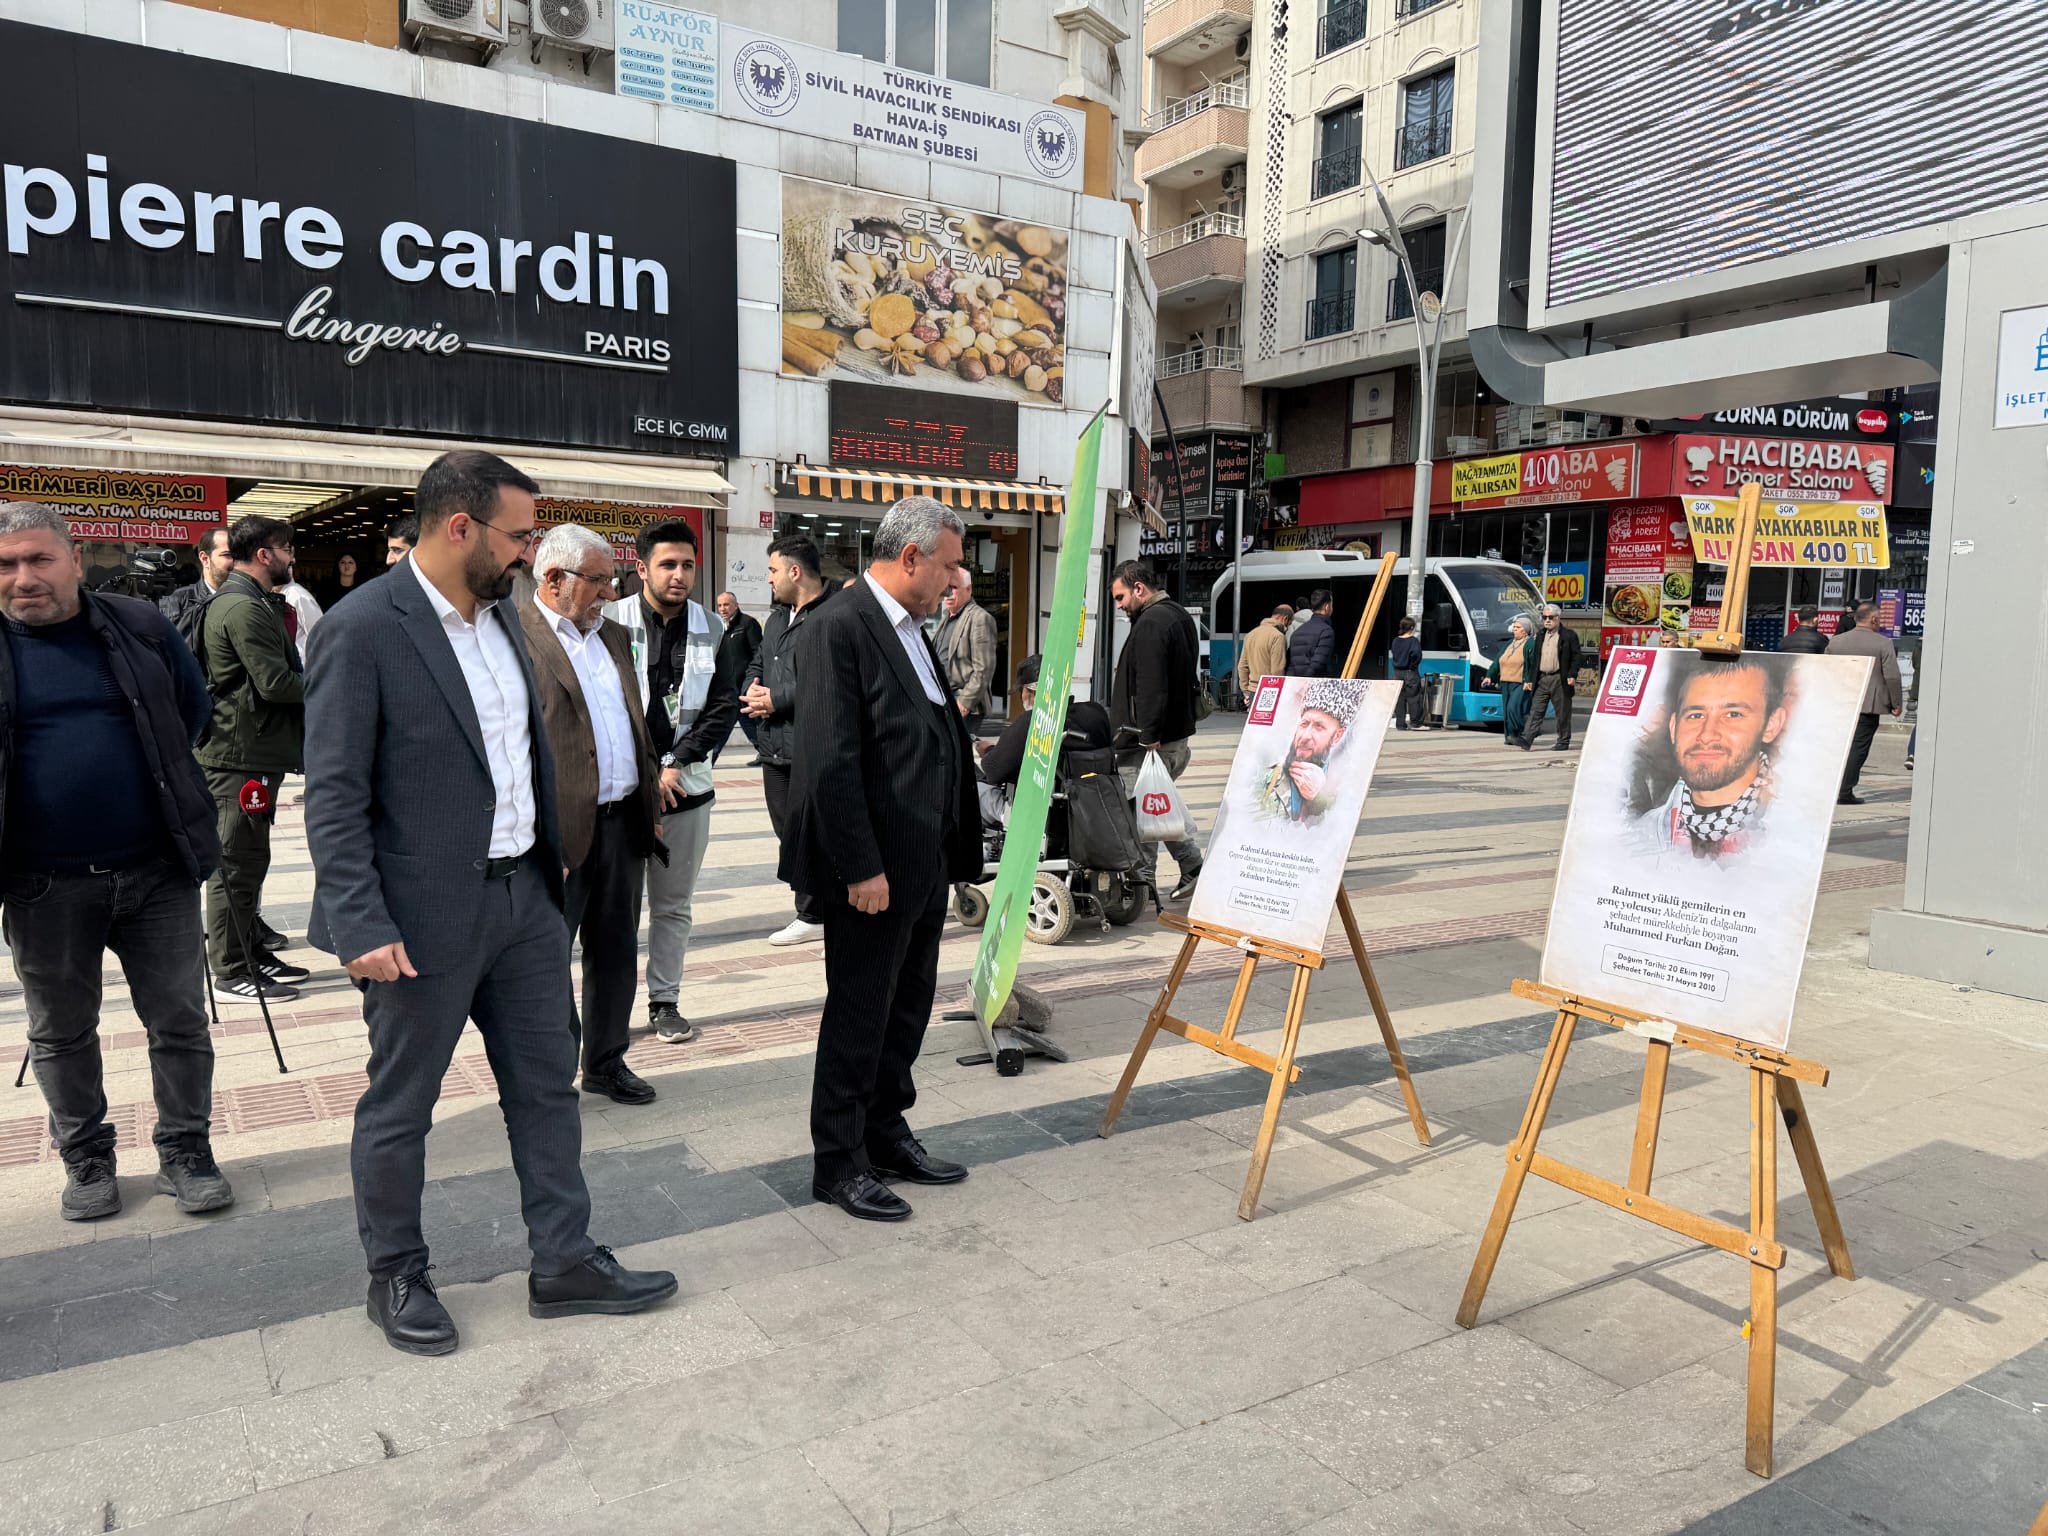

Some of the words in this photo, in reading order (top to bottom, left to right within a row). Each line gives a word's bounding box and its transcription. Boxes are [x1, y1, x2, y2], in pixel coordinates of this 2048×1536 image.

[630, 24, 704, 51] AYNUR
[883, 71, 952, 100] TÜRKİYE
[805, 71, 848, 94] SİVİL
[853, 83, 937, 116] HAVACILIK
[942, 105, 1021, 134] SENDİKASI
[887, 111, 948, 139] HAVA-İŞ
[853, 123, 918, 149] BATMAN
[923, 140, 978, 162] ŞUBESİ
[3, 153, 344, 270] pierre
[380, 220, 670, 315] cardin
[901, 207, 964, 244] SEÇ
[835, 228, 1022, 286] KURUYEMİŞ
[286, 285, 462, 366] lingerie
[585, 331, 671, 362] PARIS
[638, 418, 665, 434] ECE
[670, 419, 684, 437] İÇ
[1714, 407, 1776, 425] ZURNA
[1783, 405, 1849, 431] DÜRÜM
[1718, 438, 1862, 471] HACIBABA
[1456, 462, 1517, 482] MAĞAZAMIZDA
[1726, 466, 1784, 487] Döner
[1789, 469, 1853, 490] Salonu
[113, 480, 205, 504] BAŞLADI
[1456, 485, 1467, 497] NE
[1471, 478, 1517, 495] ALIRSAN
[1787, 490, 1804, 498] 0552
[1806, 490, 1819, 499] 396
[1820, 491, 1827, 499] 12
[1828, 491, 1837, 499] 72
[100, 505, 136, 519] TÜM
[140, 503, 220, 522] ÜRÜNLERDE
[1695, 502, 1711, 512] ŞOK
[1779, 505, 1794, 514] ŞOK
[1860, 507, 1875, 516] ŞOK
[121, 520, 189, 541] İNDİRİM
[1692, 516, 1735, 535] MARK
[1755, 519, 1857, 537] AYAKKABILAR
[1862, 521, 1880, 538] NE
[1615, 544, 1656, 553] HACIBABA
[1704, 538, 1795, 562] ALISAN
[1802, 541, 1847, 562] 400
[1852, 541, 1878, 564] TL
[1597, 896, 1620, 909] genç
[1621, 900, 1662, 916] yolcusu;
[1710, 916, 1757, 935] dalgalarını
[1612, 885, 1650, 901] Rahmet
[1651, 892, 1680, 908] yüklü
[1681, 897, 1730, 918] gemilerin
[1733, 909, 1746, 918] en
[1603, 920, 1663, 942] Muhammed
[1665, 933, 1701, 950] Furkan
[1704, 940, 1739, 957] Doğan.
[1609, 910, 1641, 925] şehadet
[1643, 916, 1701, 938] mürekkebiyle
[1702, 928, 1738, 944] boyayan
[1612, 961, 1642, 976] Şehadet
[1643, 967, 1664, 981] Tarihi:
[1676, 977, 1697, 990] Mayıs
[1698, 982, 1716, 992] 2010
[1618, 952, 1643, 966] Doğum
[1645, 958, 1667, 971] Tarihi:
[1668, 964, 1678, 972] 20
[1680, 966, 1698, 978] Ekim
[1699, 971, 1715, 981] 1991
